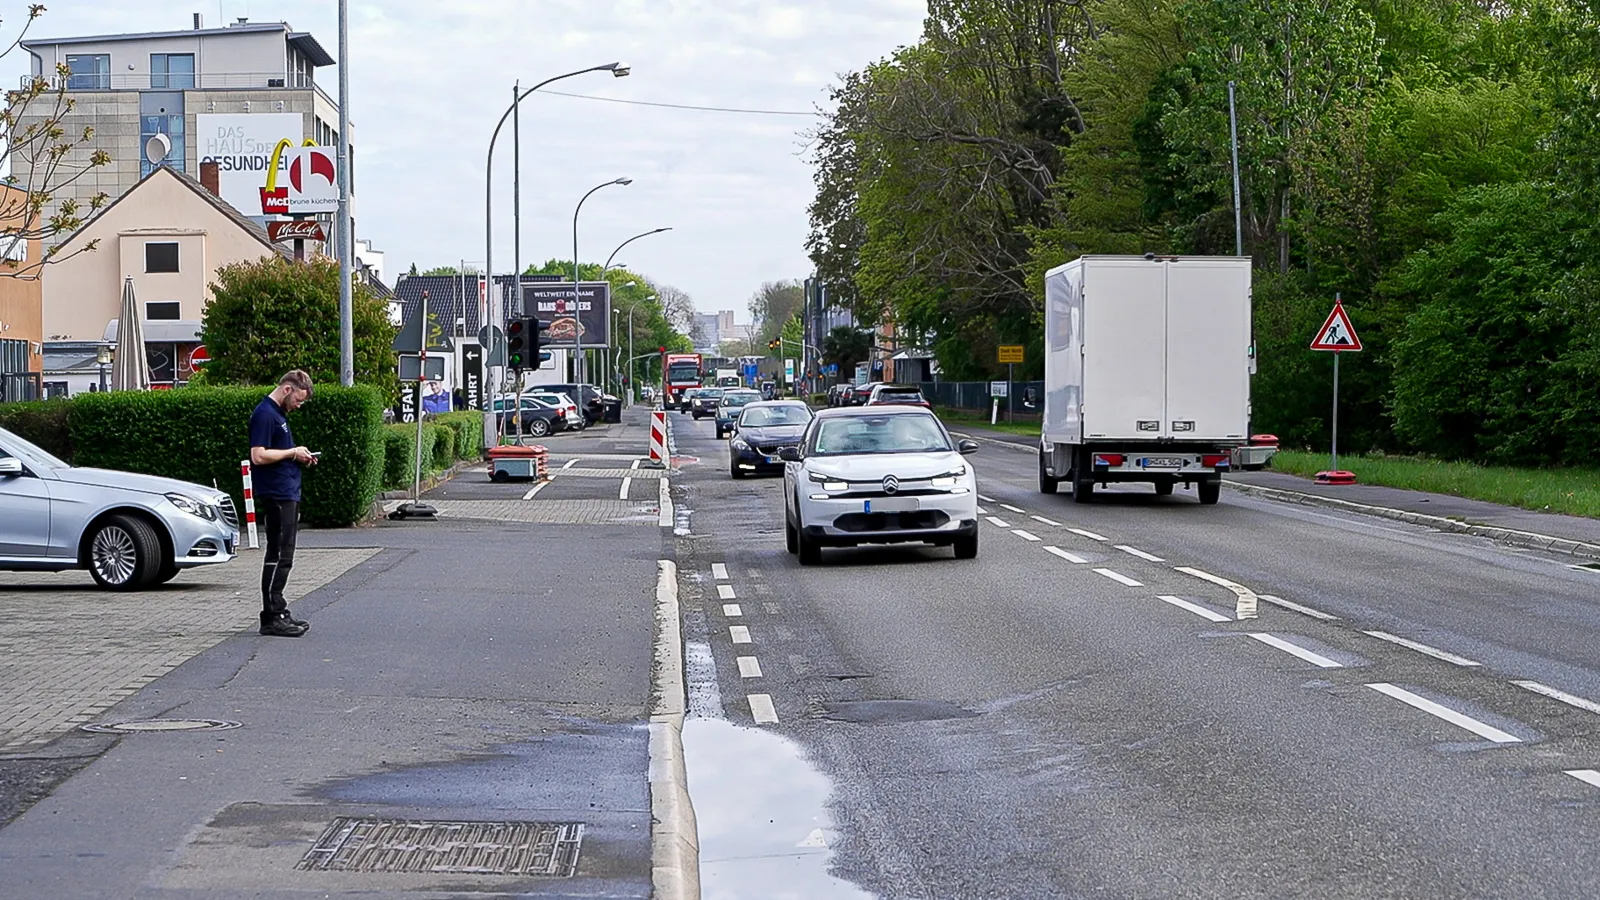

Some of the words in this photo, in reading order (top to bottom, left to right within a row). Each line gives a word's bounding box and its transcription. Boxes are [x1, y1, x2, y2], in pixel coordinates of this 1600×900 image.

[217, 126, 245, 138] DAS
[206, 138, 256, 154] HAUS
[256, 142, 278, 153] DE
[311, 197, 337, 205] küchen
